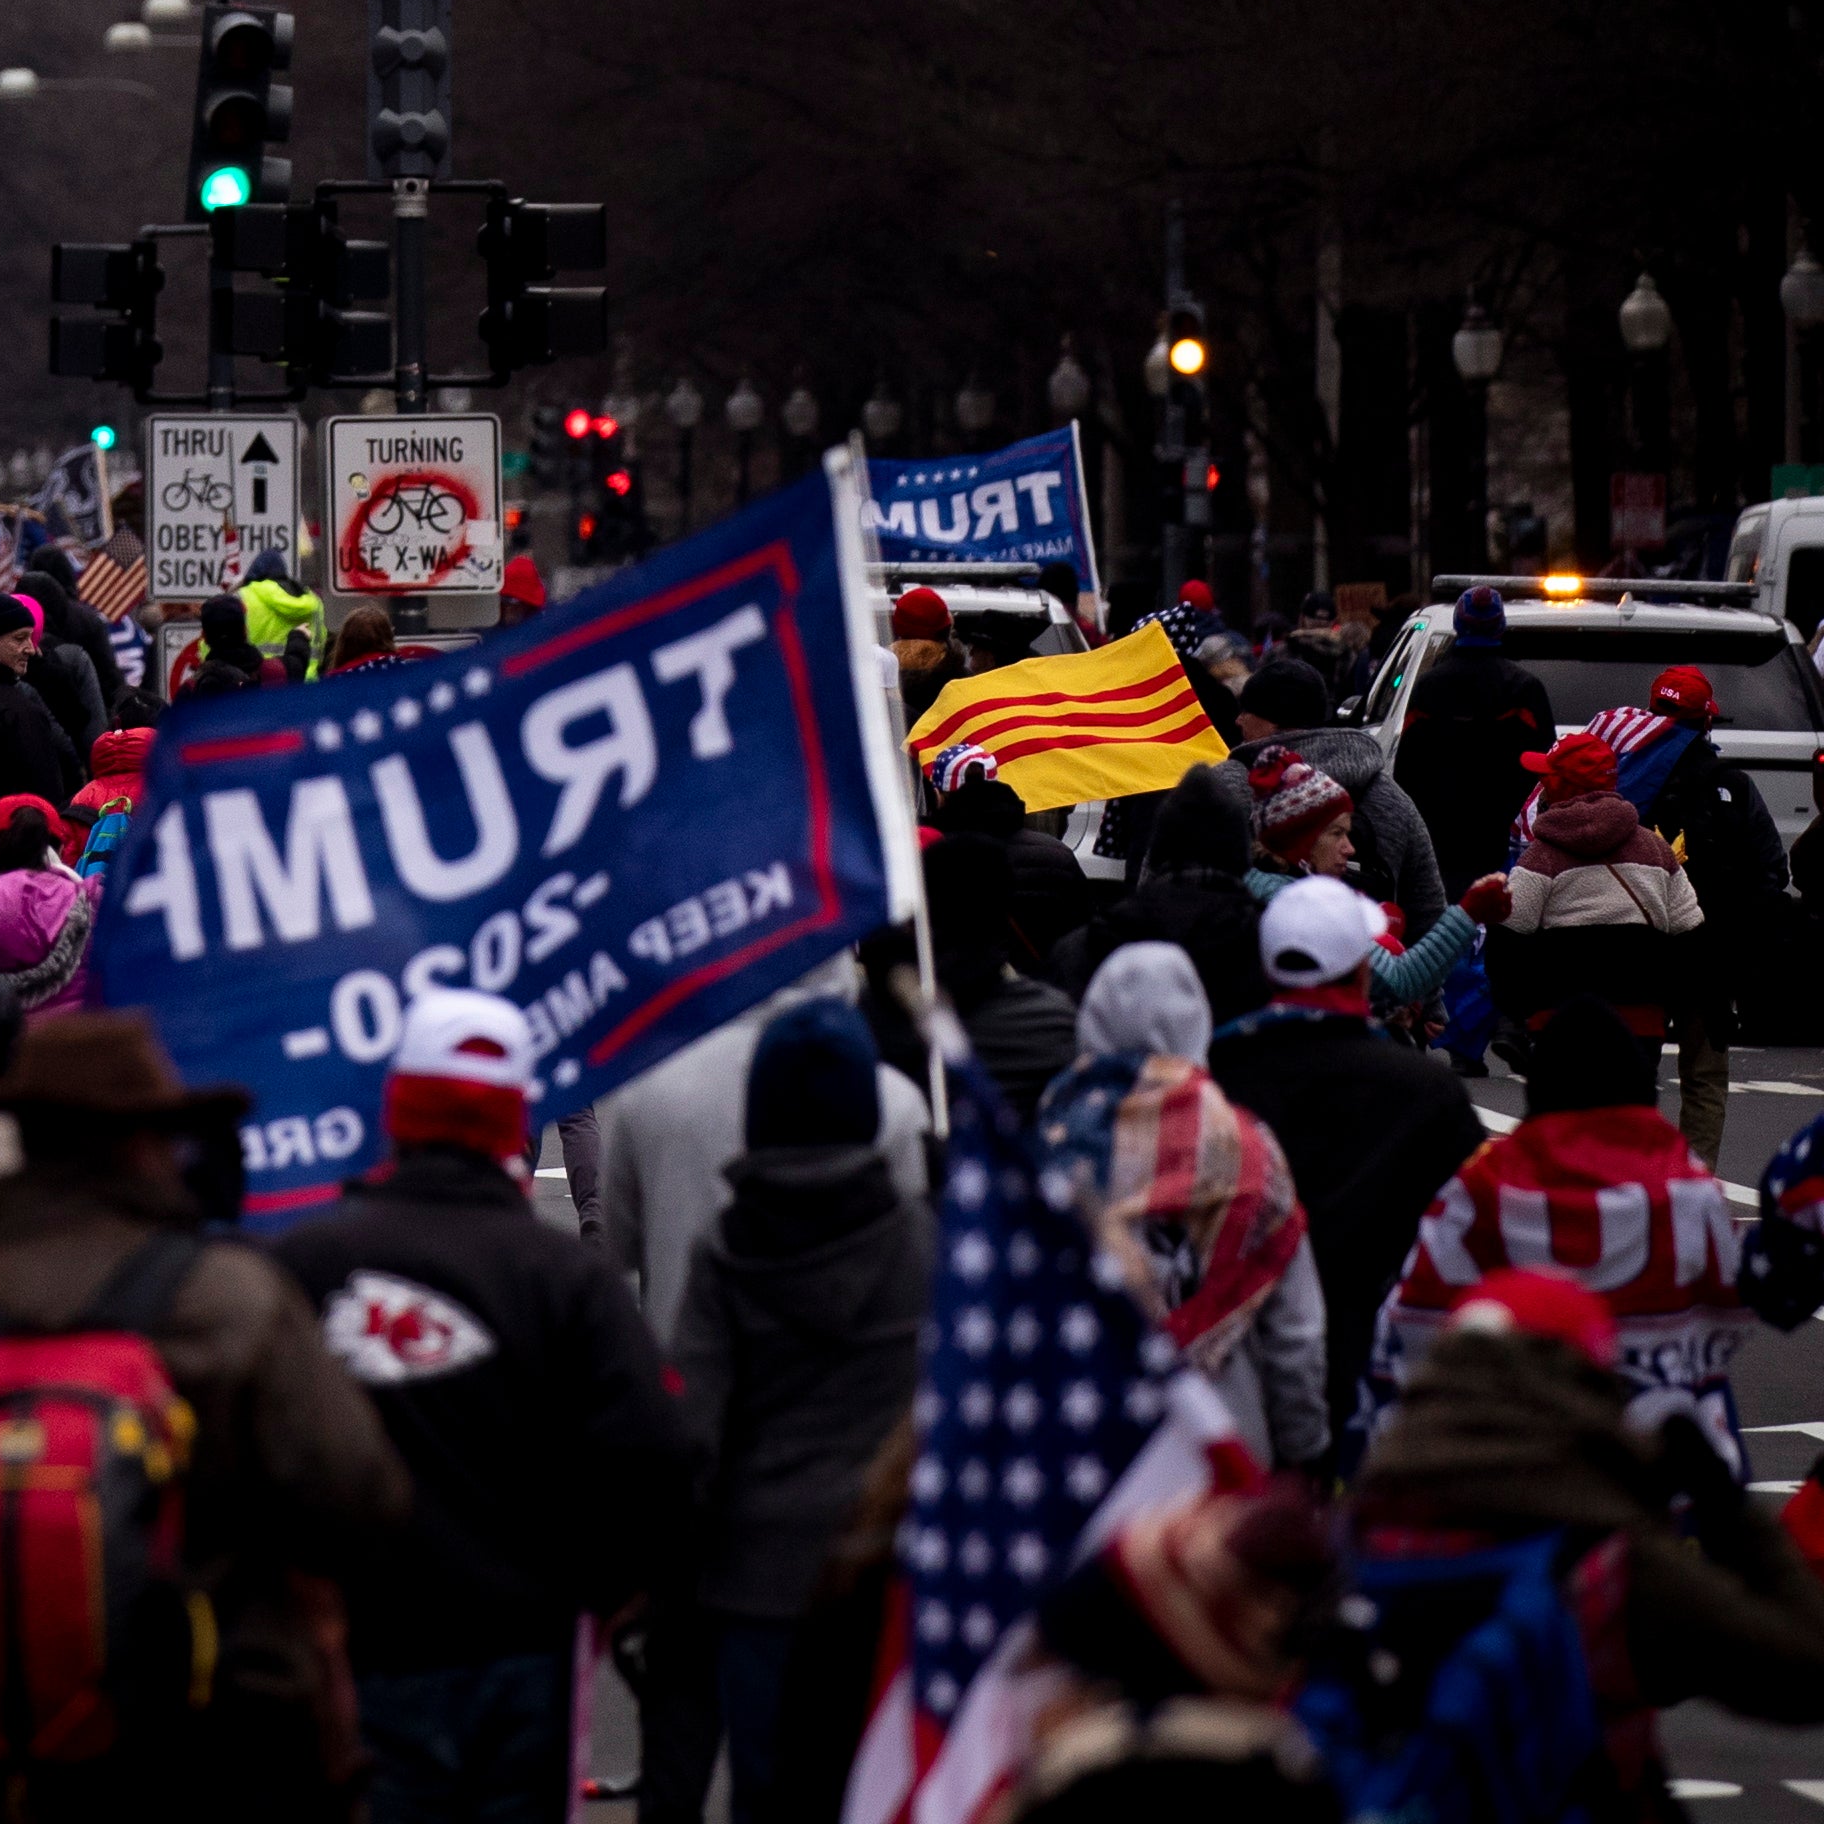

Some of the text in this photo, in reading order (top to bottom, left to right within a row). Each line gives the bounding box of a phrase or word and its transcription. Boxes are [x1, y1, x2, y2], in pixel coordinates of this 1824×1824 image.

[162, 429, 225, 457] THRU
[366, 437, 464, 464] TURNING
[158, 524, 290, 553] OBEY THIS
[1660, 686, 1681, 700] USA
